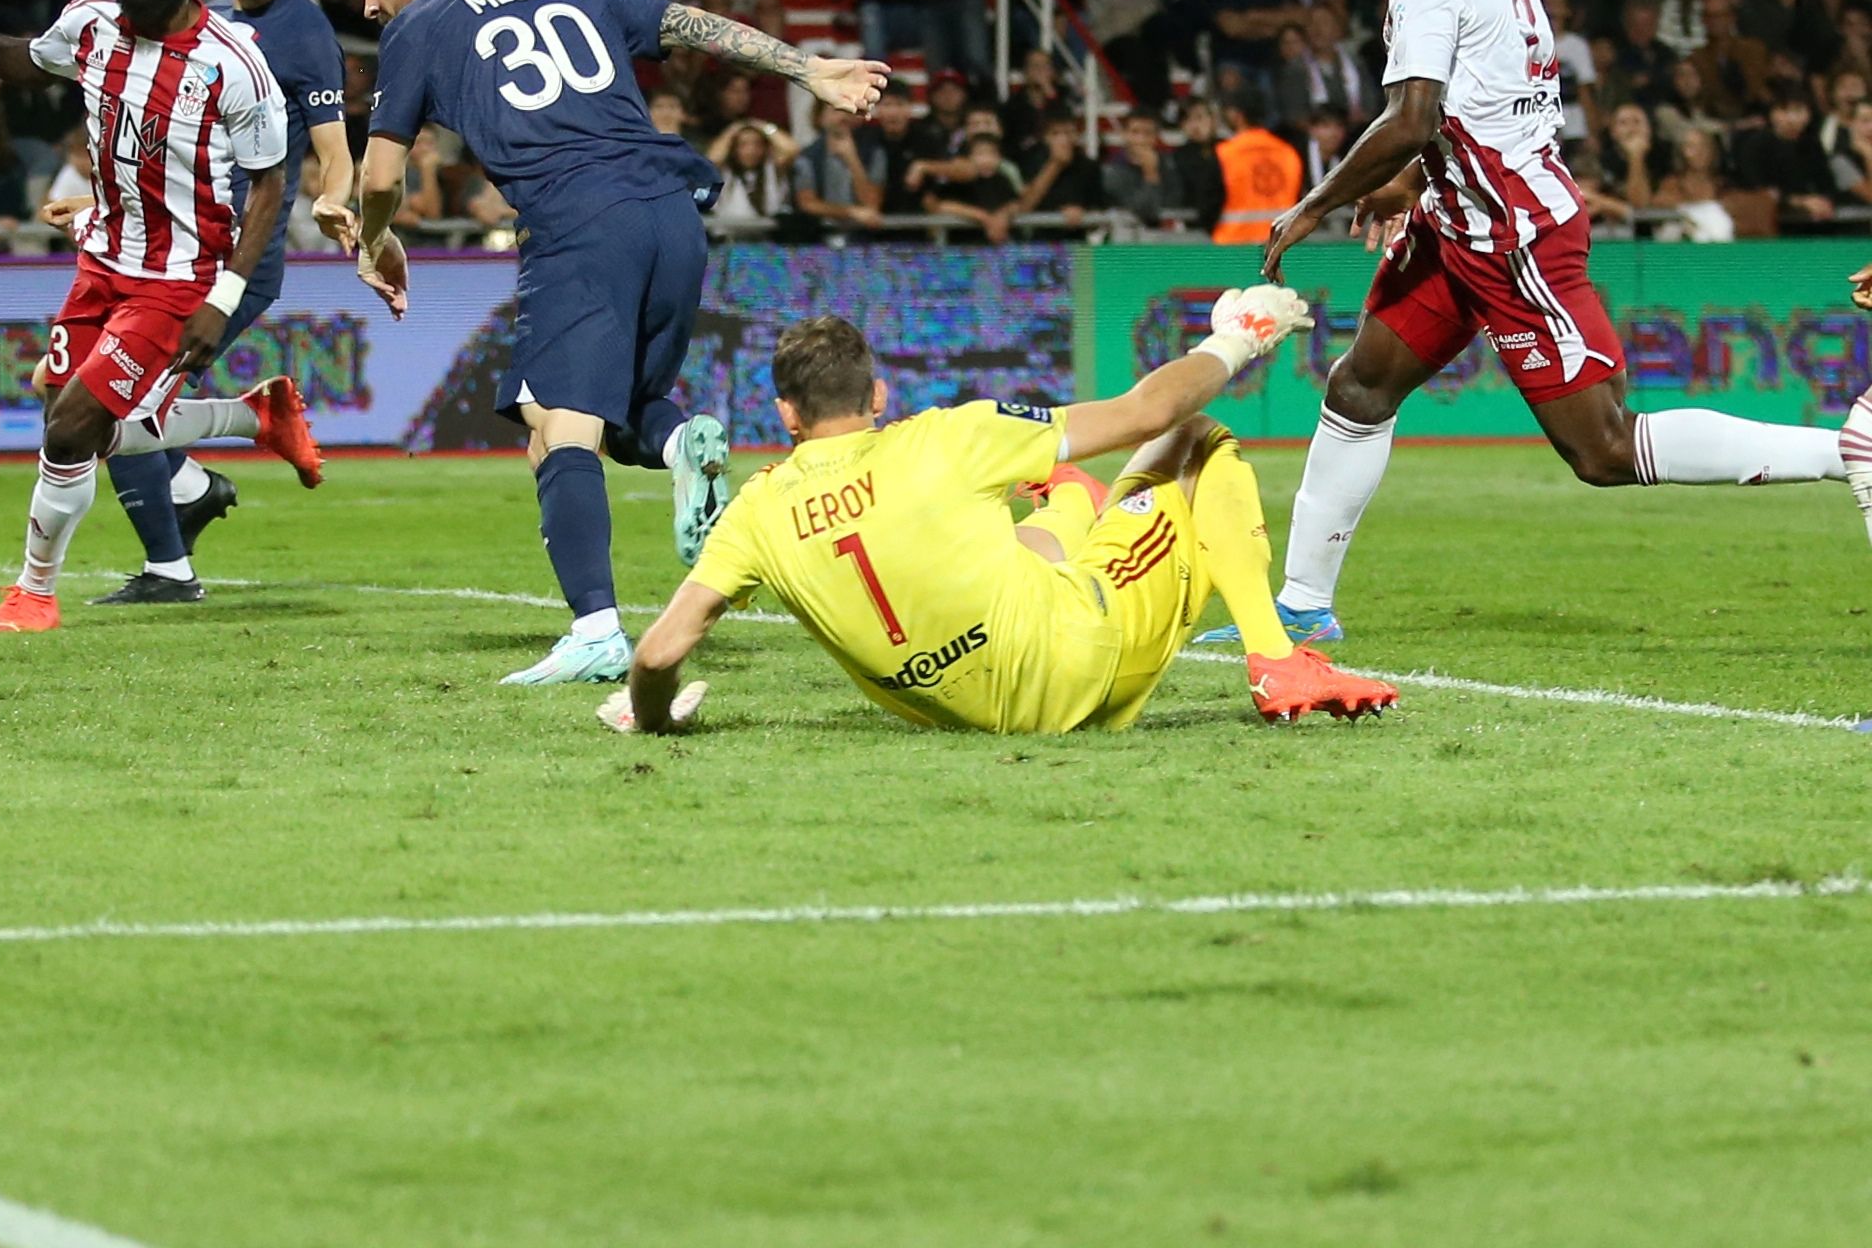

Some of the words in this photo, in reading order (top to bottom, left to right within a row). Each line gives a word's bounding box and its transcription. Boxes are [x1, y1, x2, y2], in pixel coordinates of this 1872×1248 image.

[474, 3, 615, 111] 30
[48, 324, 70, 375] 3
[791, 470, 876, 541] LEROY
[832, 531, 908, 647] 1
